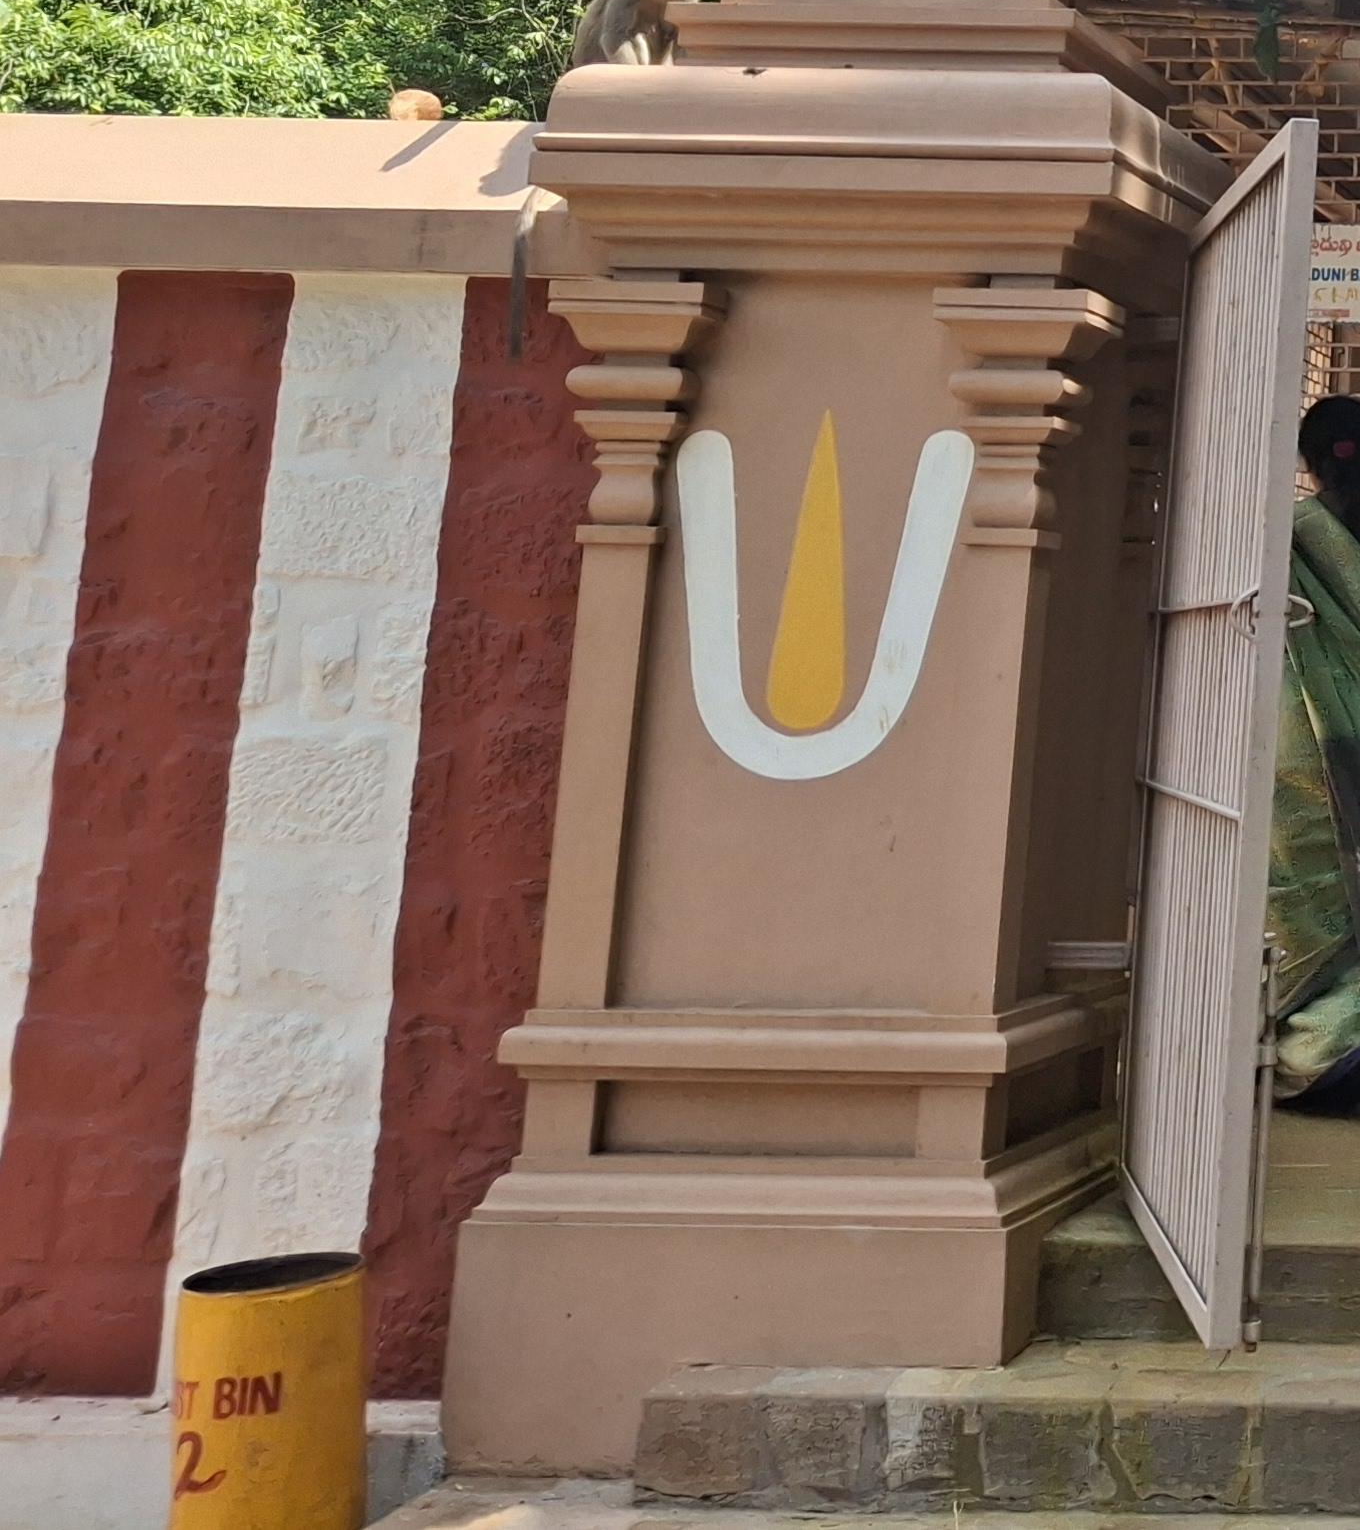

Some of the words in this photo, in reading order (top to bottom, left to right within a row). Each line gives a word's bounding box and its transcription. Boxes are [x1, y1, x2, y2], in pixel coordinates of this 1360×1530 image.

[1311, 268, 1346, 281] DUNI
[213, 1371, 283, 1420] BIN
[173, 1430, 228, 1502] 2
